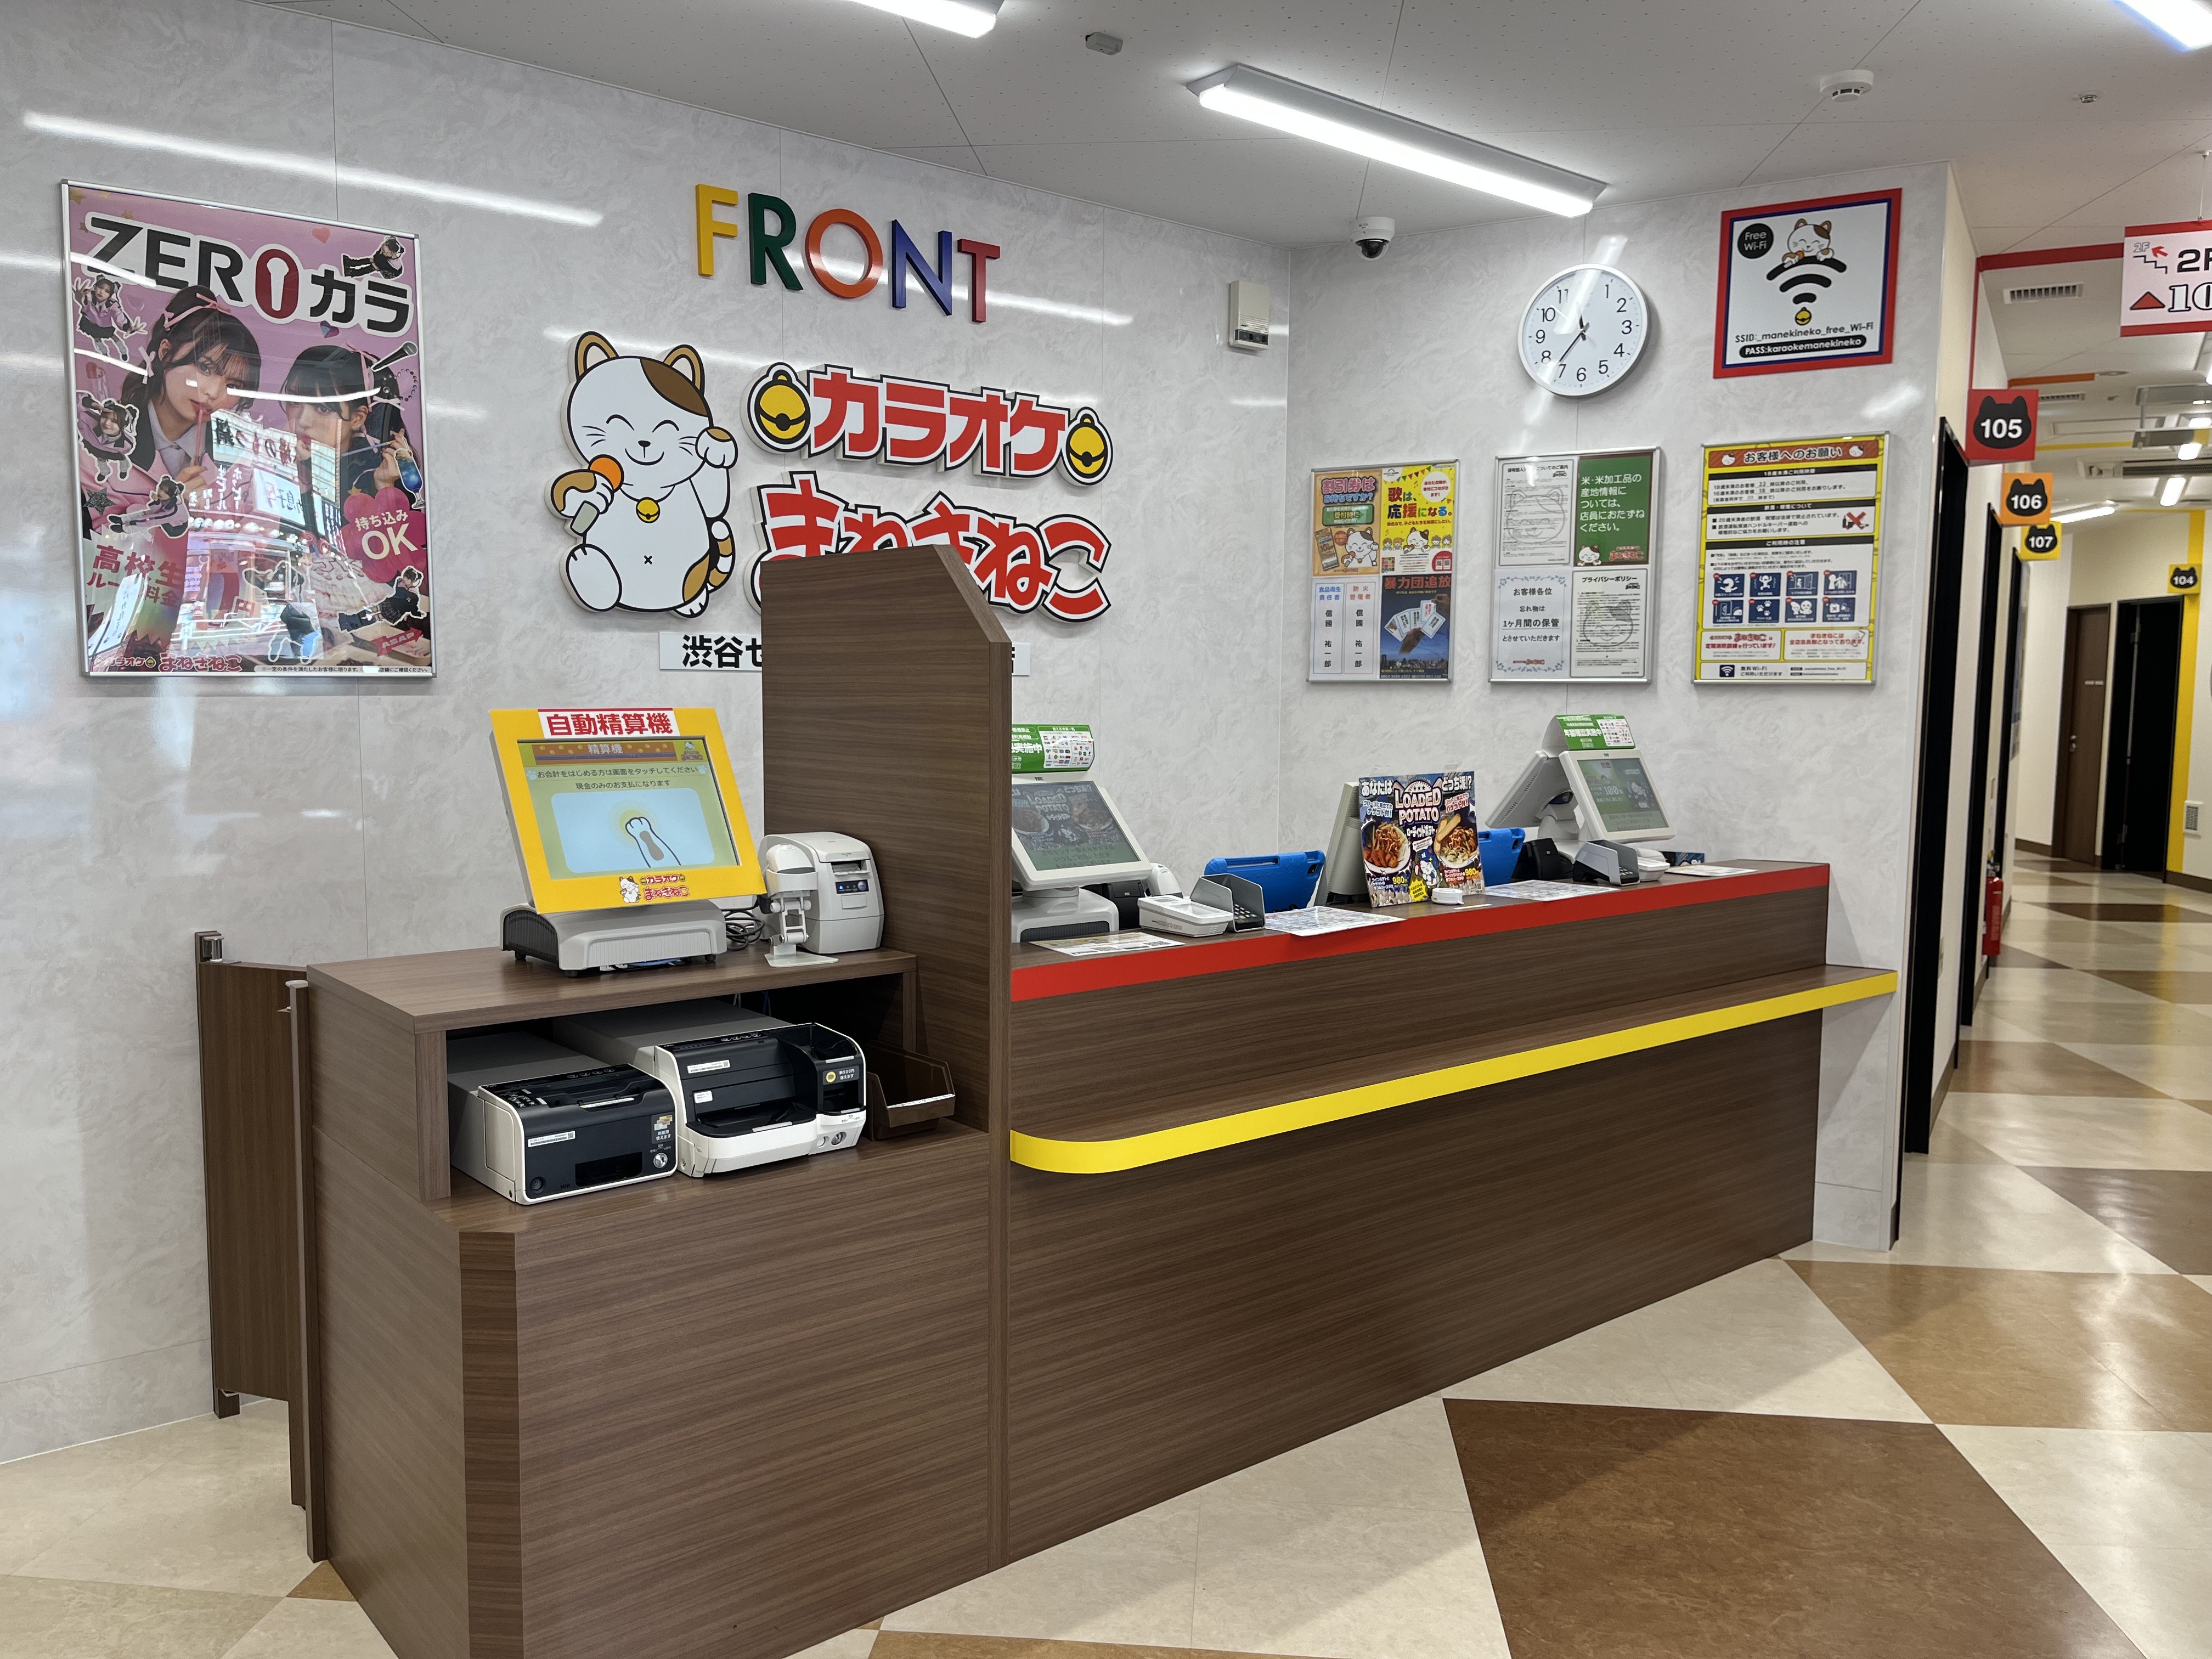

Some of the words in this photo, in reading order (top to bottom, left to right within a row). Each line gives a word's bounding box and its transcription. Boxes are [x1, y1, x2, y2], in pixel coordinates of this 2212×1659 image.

[1745, 230, 1767, 240] Free
[1744, 240, 1767, 251] Wi-Fi
[2133, 242, 2150, 253] 2F
[696, 184, 1001, 323] FRONT
[1558, 289, 1568, 303] 11
[1605, 284, 1609, 298] 1
[1616, 298, 1627, 313] 2
[1542, 307, 1555, 322] 10
[1621, 320, 1632, 335] 3
[1536, 329, 1545, 343] 9
[1613, 343, 1624, 357] 4
[1745, 338, 1862, 356] PASS:karaokemanekineko
[1541, 350, 1551, 363] 8
[1559, 364, 1566, 378] 7
[1598, 359, 1608, 374] 5
[1577, 367, 1586, 381] 6
[811, 368, 1069, 476] カラオケ
[1980, 418, 2023, 439] 105
[1744, 447, 1843, 463] お客様へのお願い
[1322, 477, 1375, 494] 割引券は
[1581, 473, 1642, 485] 米・米加工品の
[1388, 487, 1417, 502] 歌は、
[1581, 486, 1627, 497] 産地情報に
[1581, 499, 1621, 509] ついては、
[2011, 494, 2042, 510] 106
[1387, 503, 1452, 519] 応援になる。
[1580, 509, 1645, 521] 店員におたずね
[355, 509, 408, 532] 持ち込み
[1580, 523, 1620, 532] ください。
[362, 523, 418, 561] OK
[2029, 535, 2053, 548] 107
[92, 544, 184, 590] 高校生
[1384, 575, 1451, 590] 暴力団追放
[2173, 574, 2193, 585] 104
[87, 572, 181, 607] ルー料金
[1513, 588, 1552, 596] お客様各位
[382, 631, 415, 648] ASAP
[158, 650, 242, 672] まねきねこ
[549, 712, 673, 737] 自動精算機
[588, 743, 624, 754] 精算機
[537, 765, 698, 778] お会計をはじめる方は画面をタッチしてください
[575, 780, 671, 790] 現金のみのお支払になります
[1362, 780, 1393, 797] あなたは
[1442, 775, 1472, 792] どっち派!?
[1026, 793, 1067, 805] LOADED
[1395, 786, 1442, 808] LOADED
[1035, 804, 1070, 814] POTATO
[1363, 800, 1393, 809] グローブに見立てた
[1367, 808, 1392, 818] ナゲット付!
[1398, 806, 1440, 825] POTATO
[646, 874, 680, 884] カラオケ
[644, 886, 689, 900] まねきねこ
